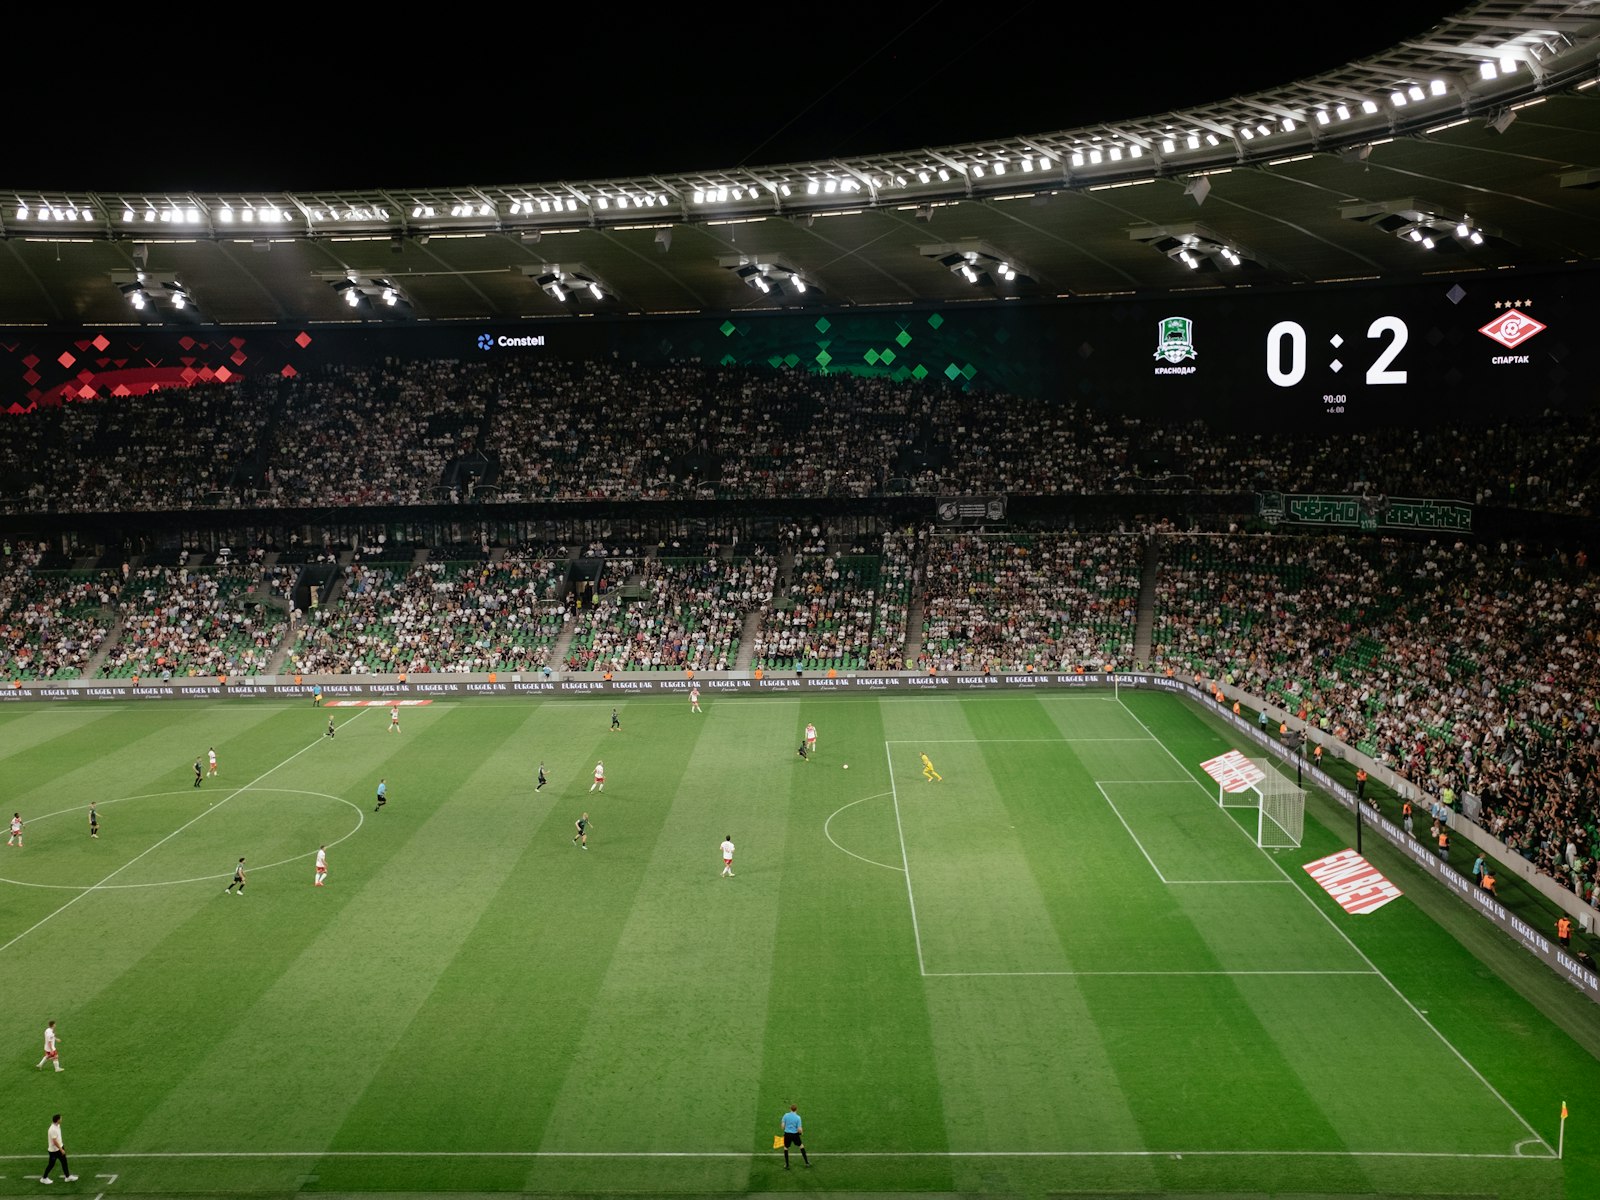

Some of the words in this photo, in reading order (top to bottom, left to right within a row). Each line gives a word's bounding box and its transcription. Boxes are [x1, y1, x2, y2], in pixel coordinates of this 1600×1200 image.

[498, 336, 545, 347] Constell
[1266, 320, 1307, 388] 0
[1366, 316, 1408, 385] 2
[1492, 356, 1530, 364] СПАРТАК
[1154, 367, 1196, 376] КРАСНОДАР
[1322, 394, 1347, 404] 90:00
